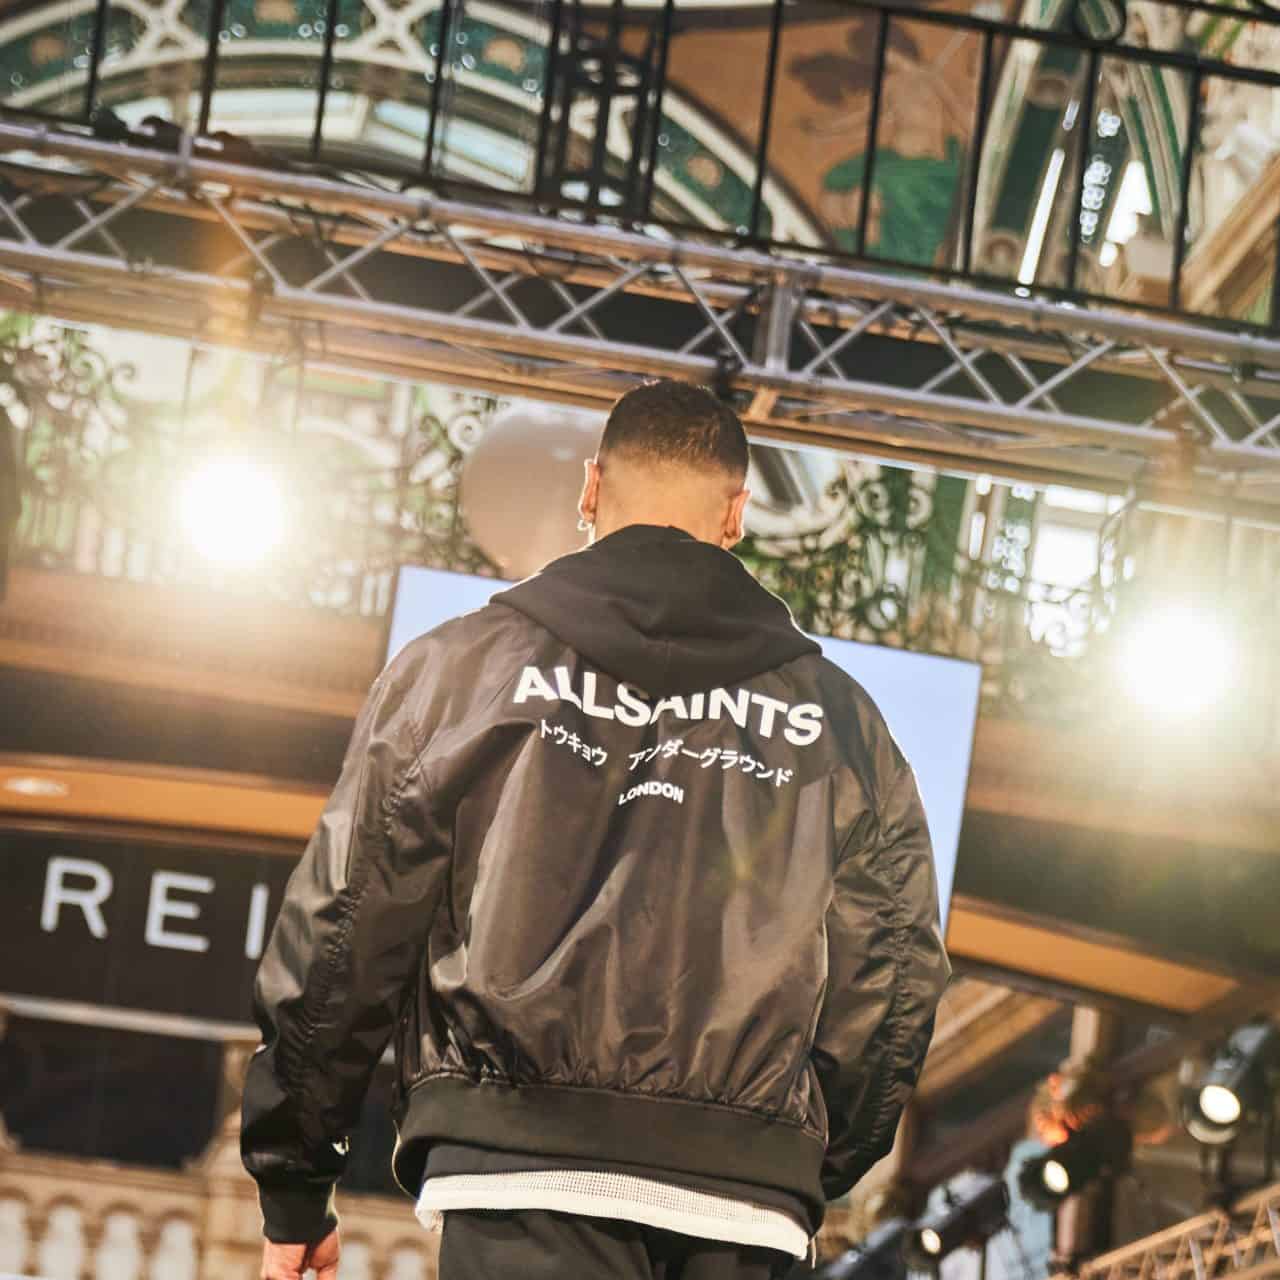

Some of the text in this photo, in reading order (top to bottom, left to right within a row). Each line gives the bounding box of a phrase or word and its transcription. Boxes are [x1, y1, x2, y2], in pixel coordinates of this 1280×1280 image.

[512, 665, 825, 747] ALLSAINTS
[540, 718, 794, 788] トウキョウ アンダーグラウンド
[617, 780, 685, 806] LONDON
